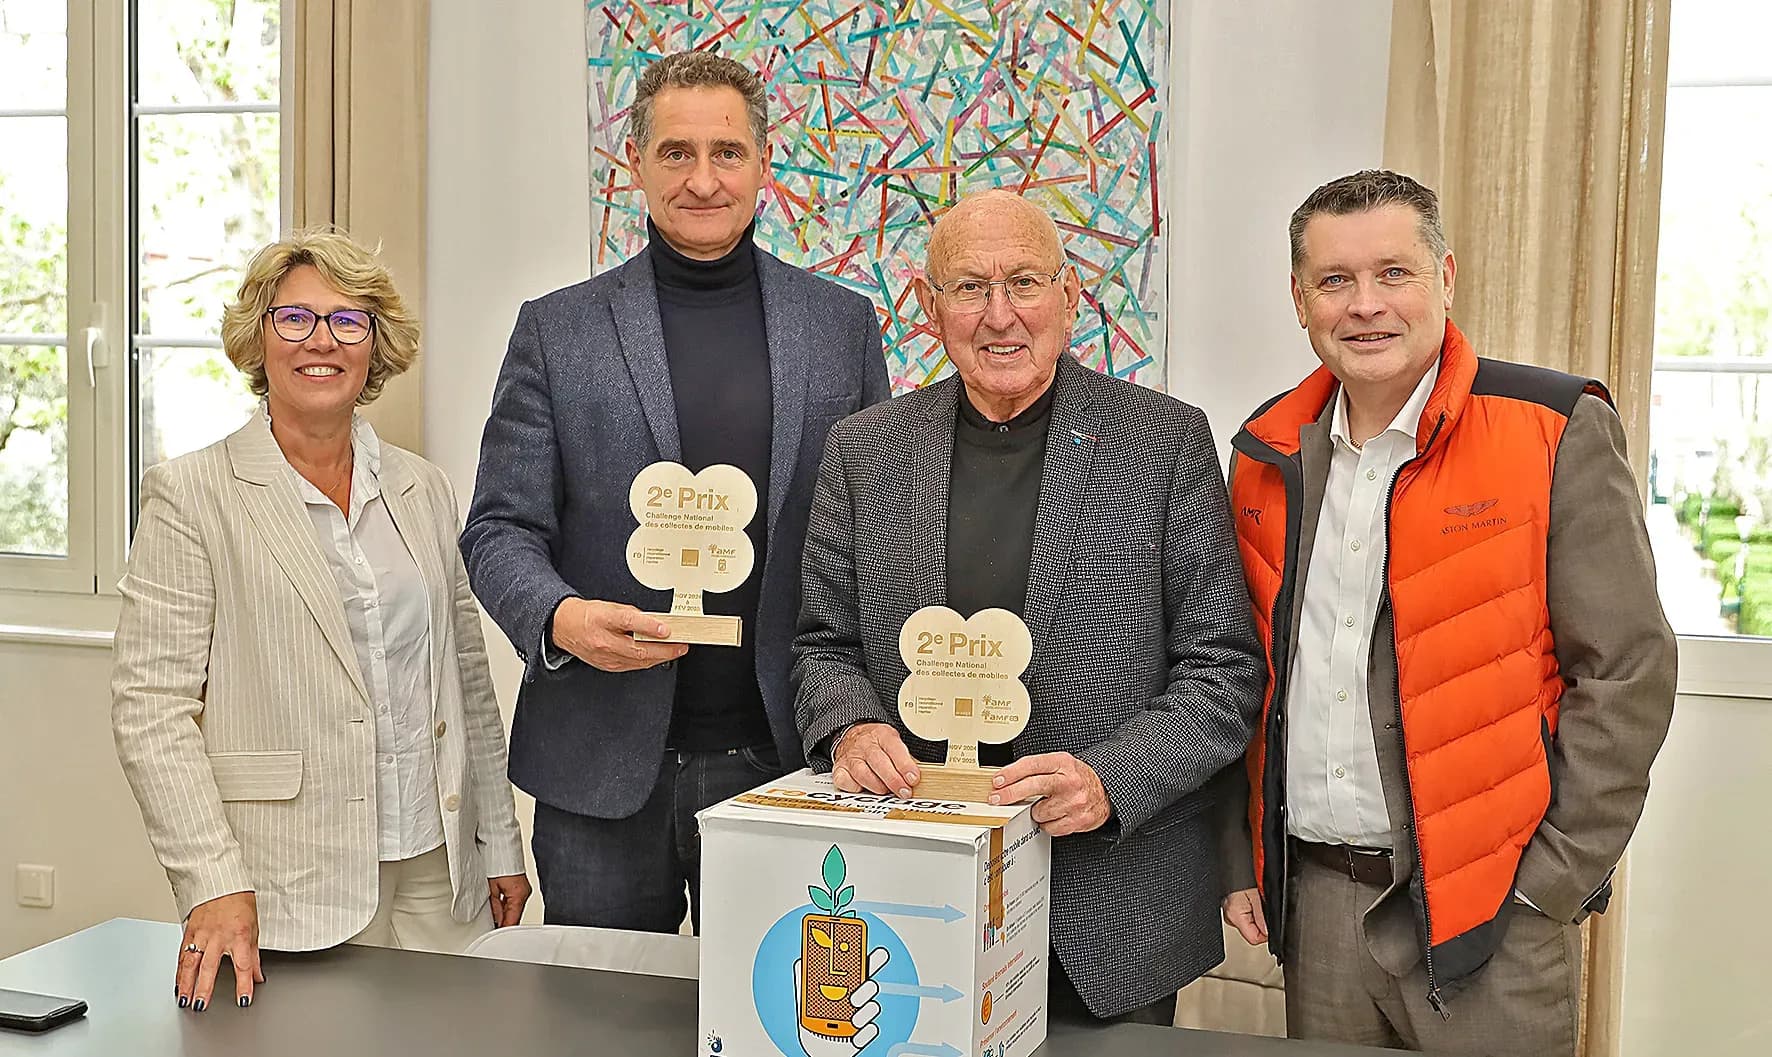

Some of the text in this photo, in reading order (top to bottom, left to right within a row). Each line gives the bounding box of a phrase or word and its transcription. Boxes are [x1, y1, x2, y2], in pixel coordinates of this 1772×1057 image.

[647, 486, 729, 511] 2e Prix
[645, 511, 714, 521] Challenge National
[660, 522, 693, 530] collectes
[705, 524, 734, 532] mobiles
[1440, 517, 1507, 535] ASTON MARTIN
[917, 631, 1003, 657] 2e Prix
[916, 659, 987, 669] Challenge National
[931, 670, 966, 678] collectes
[978, 672, 1009, 680] mobiles
